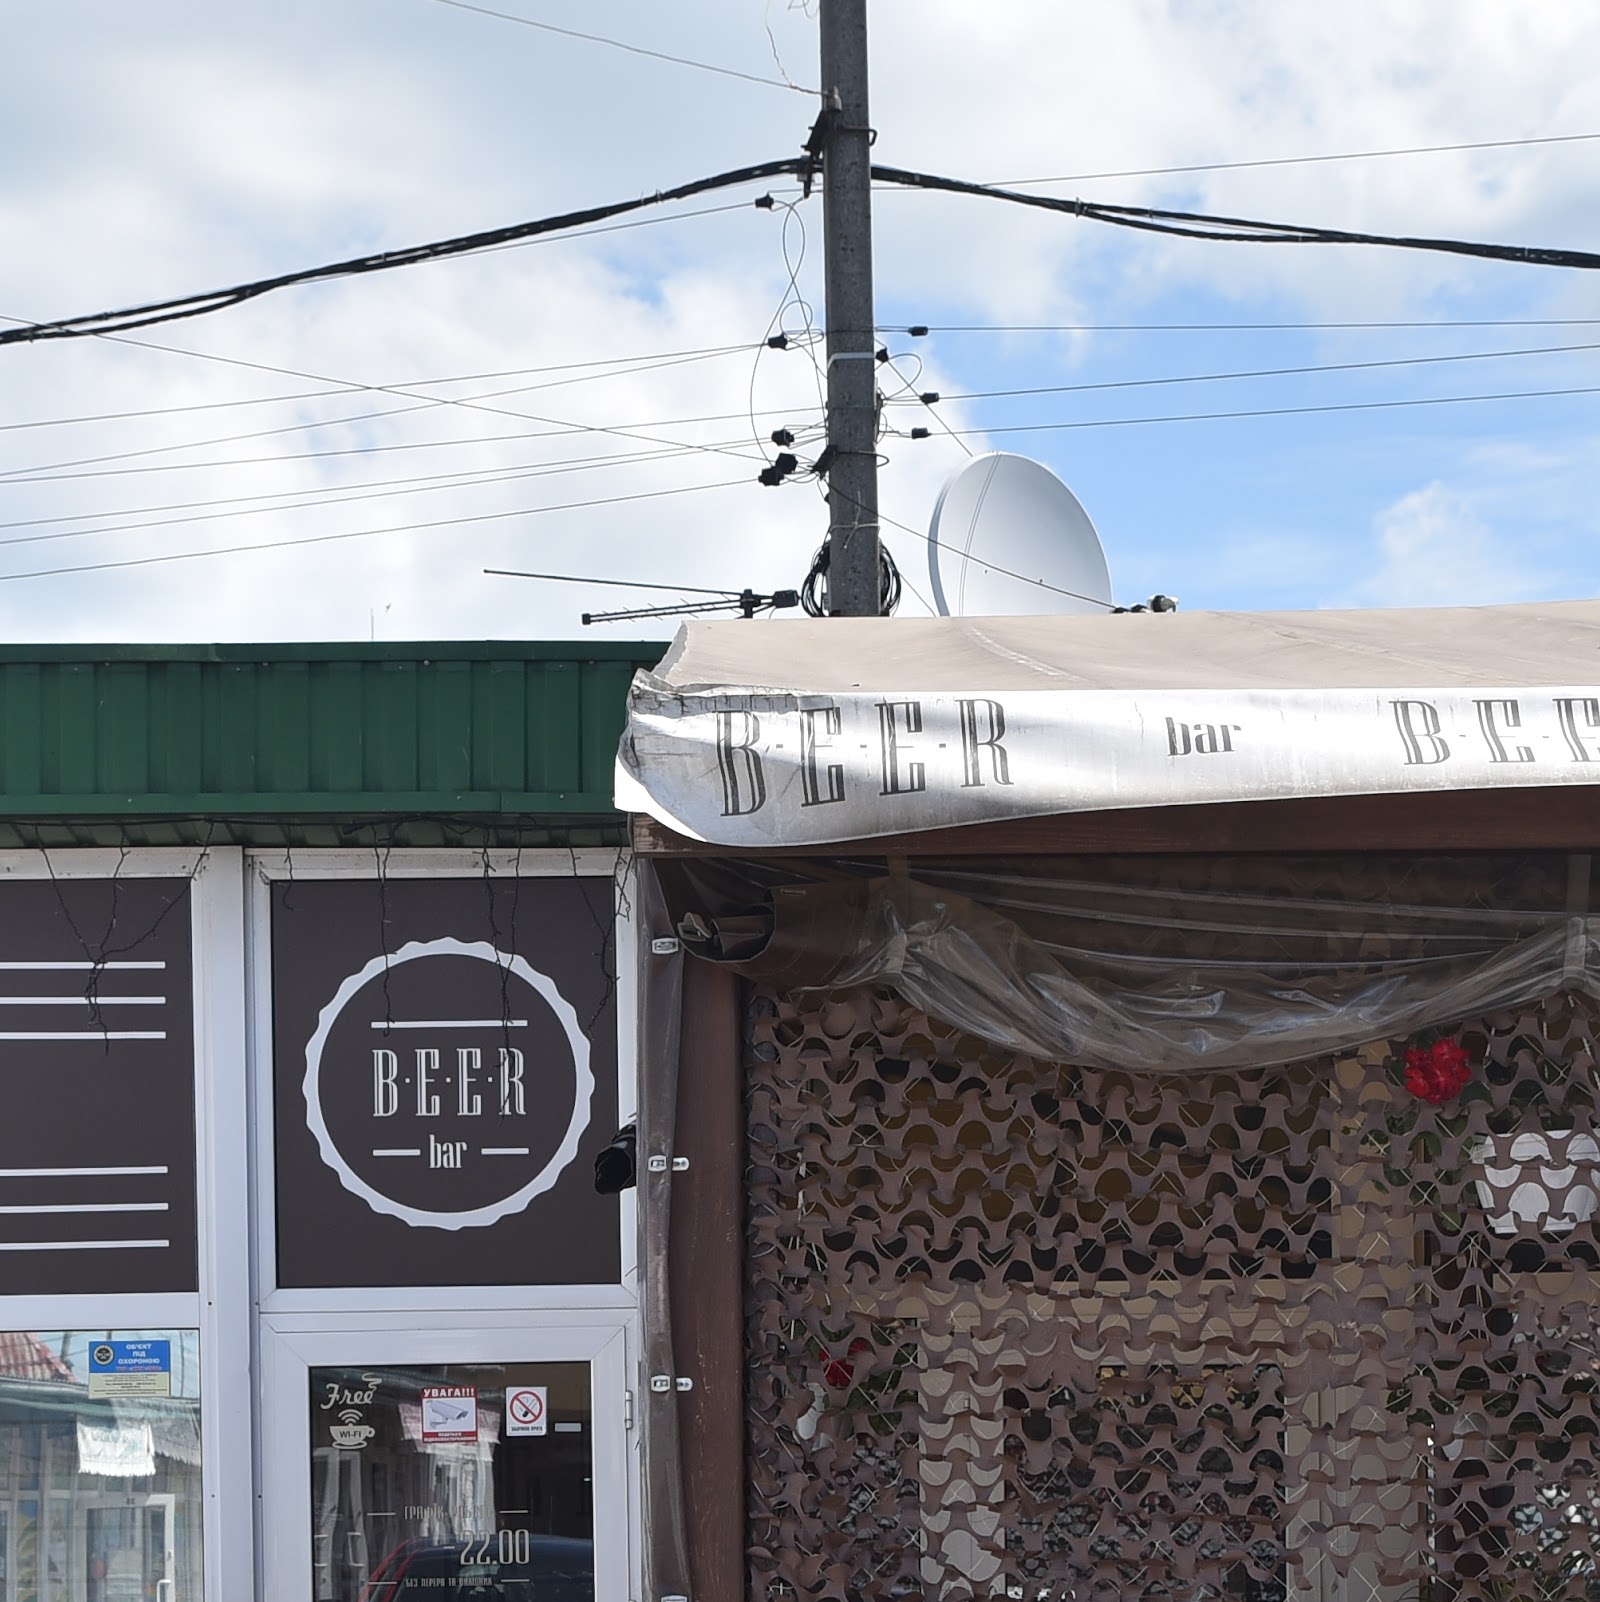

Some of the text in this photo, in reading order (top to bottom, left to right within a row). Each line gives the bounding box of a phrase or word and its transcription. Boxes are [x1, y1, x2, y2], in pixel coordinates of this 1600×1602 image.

[716, 698, 1014, 817] BEER
[1165, 716, 1242, 757] bar
[429, 1134, 468, 1169] bar
[320, 1382, 374, 1409] Free
[423, 1387, 475, 1397] УВАГА!!!
[339, 1430, 362, 1439] WI-FI
[460, 1528, 530, 1565] 22.00
[405, 1578, 418, 1587] БЕЗ
